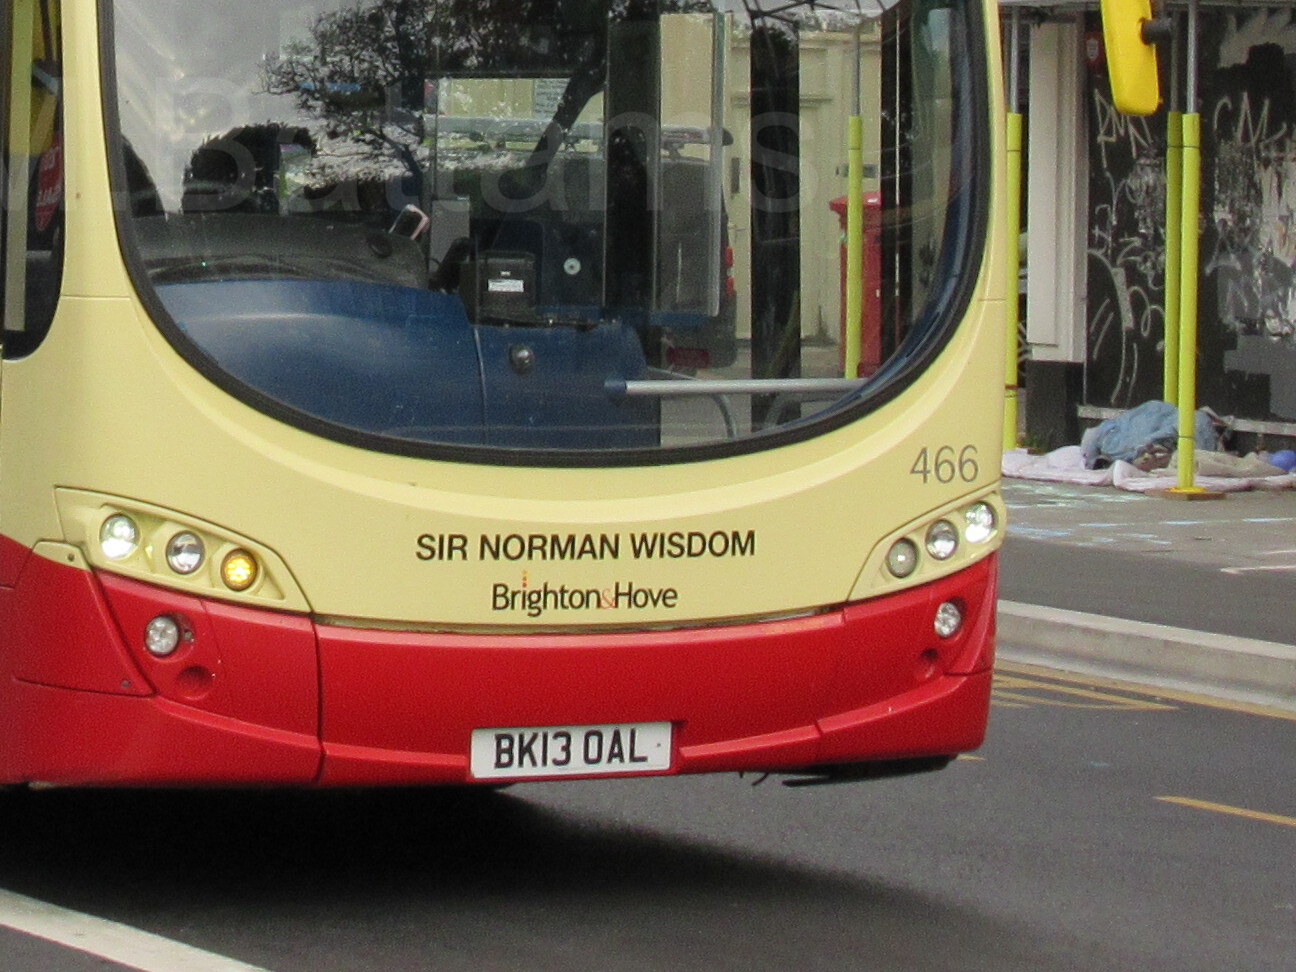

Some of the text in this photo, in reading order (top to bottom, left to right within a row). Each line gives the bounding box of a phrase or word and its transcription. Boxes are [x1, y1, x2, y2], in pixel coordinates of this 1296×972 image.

[909, 444, 979, 484] 466
[415, 530, 756, 561] SIR NORMAN WISDOM
[494, 730, 572, 769] BK13
